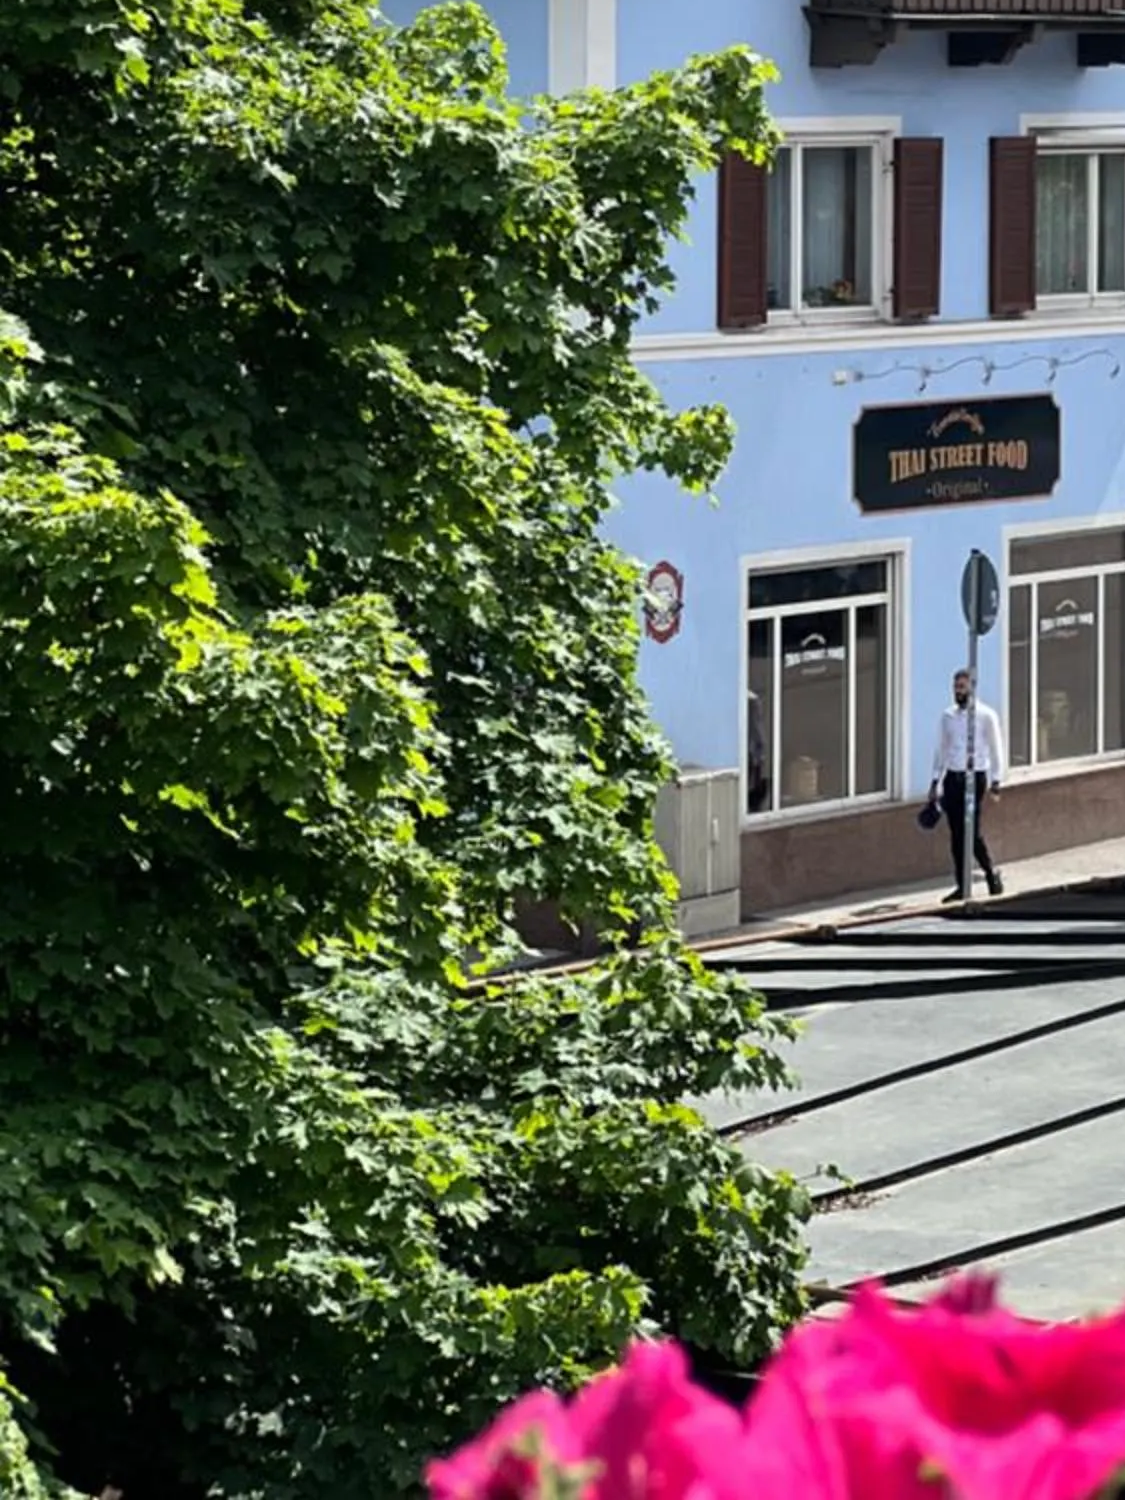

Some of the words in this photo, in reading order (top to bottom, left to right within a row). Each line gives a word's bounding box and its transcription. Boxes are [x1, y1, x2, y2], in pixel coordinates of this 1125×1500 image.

[889, 450, 926, 483] THAI
[930, 443, 984, 472] STREET
[988, 440, 1027, 470] FOOD
